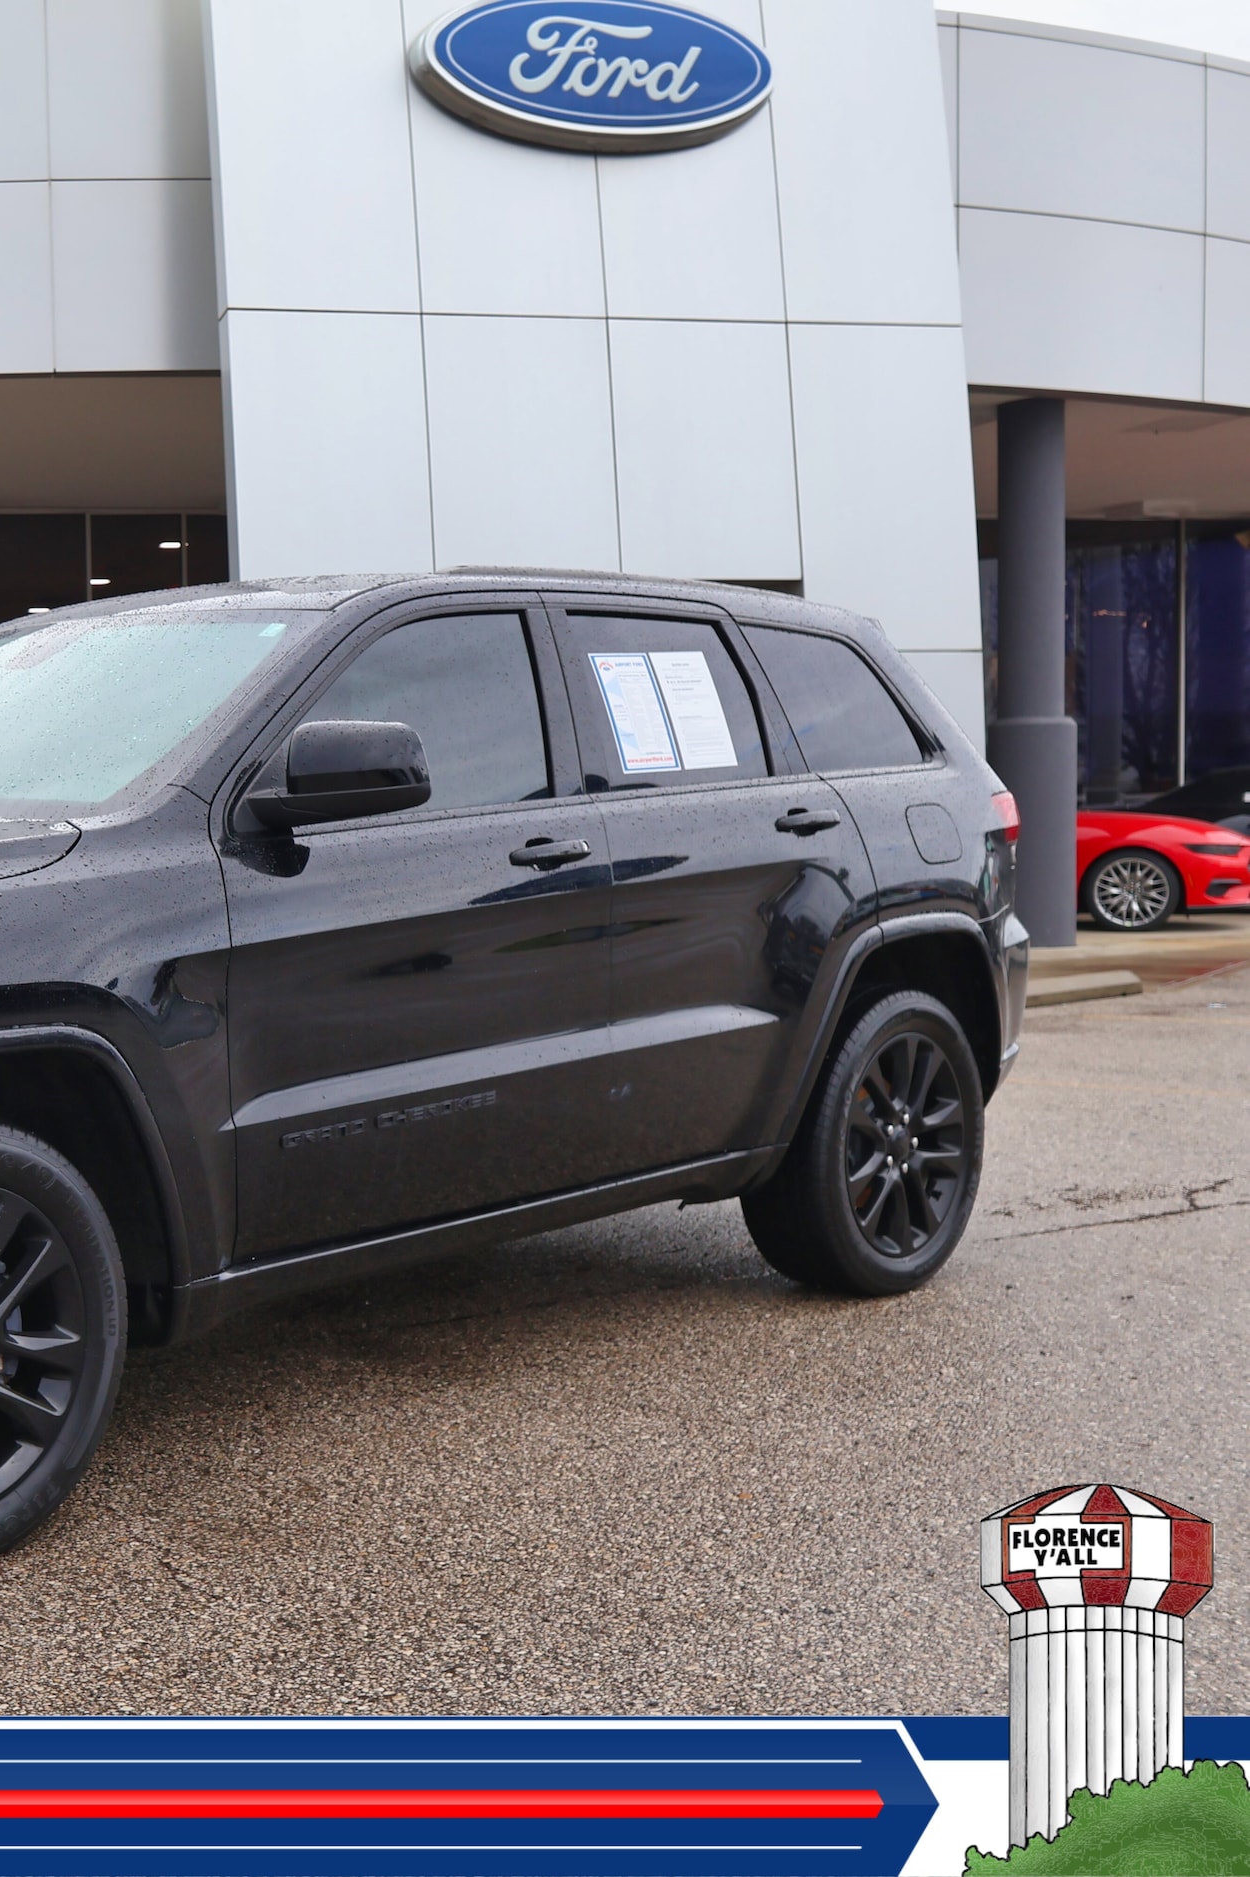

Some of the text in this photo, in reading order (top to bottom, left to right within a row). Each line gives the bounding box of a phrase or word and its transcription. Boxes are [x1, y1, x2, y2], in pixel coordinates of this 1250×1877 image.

[508, 15, 702, 103] Ford
[279, 1089, 497, 1149] GRAND CHEROKEE
